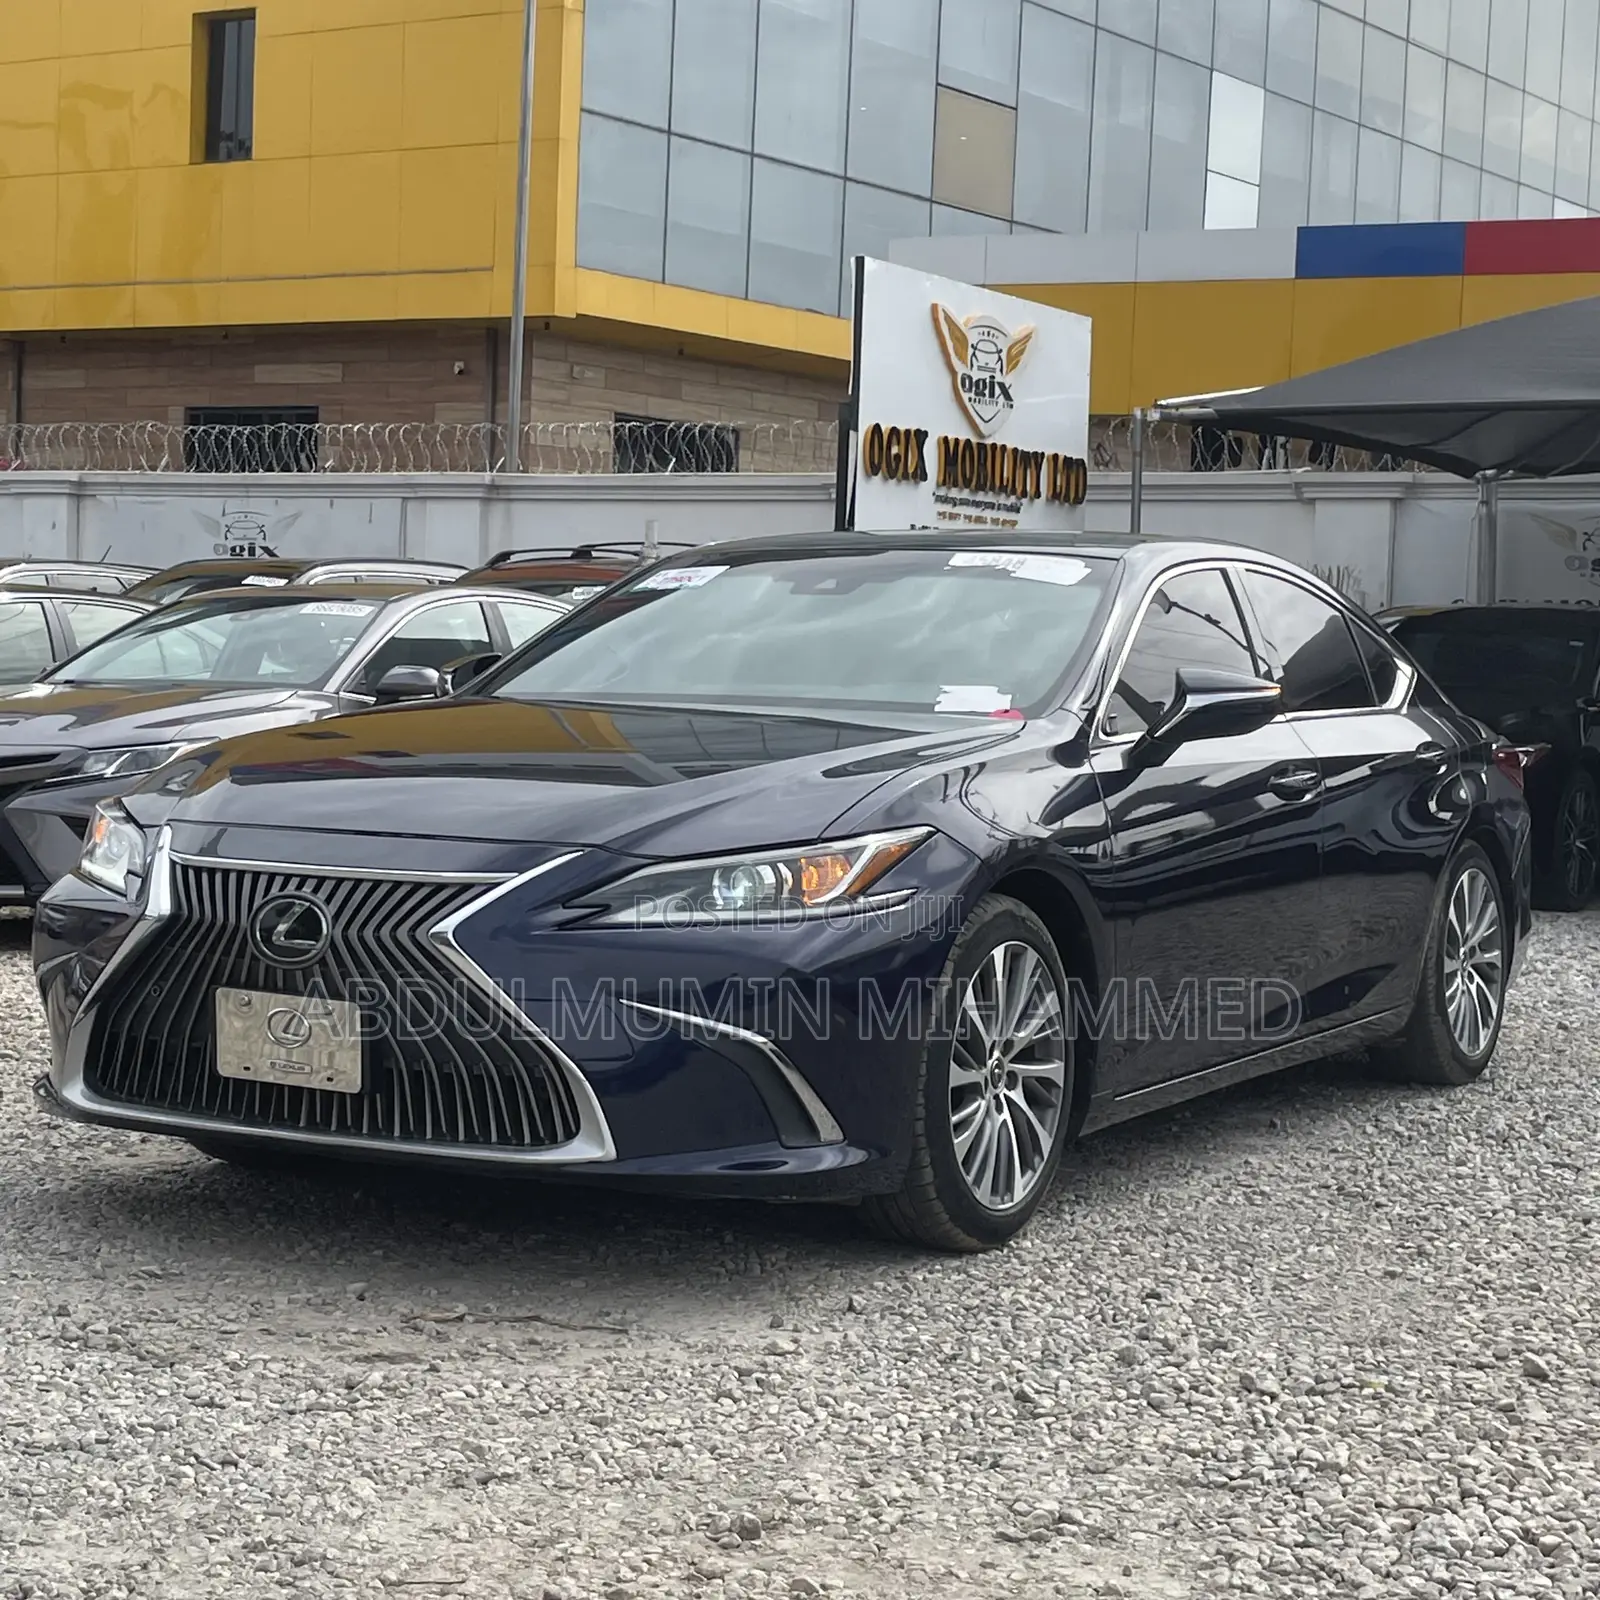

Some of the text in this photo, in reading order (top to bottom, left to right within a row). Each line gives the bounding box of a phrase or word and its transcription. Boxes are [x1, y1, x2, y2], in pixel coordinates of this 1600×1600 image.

[960, 373, 1014, 402] ogix
[863, 422, 1088, 506] OGIX MOBILITY LTD
